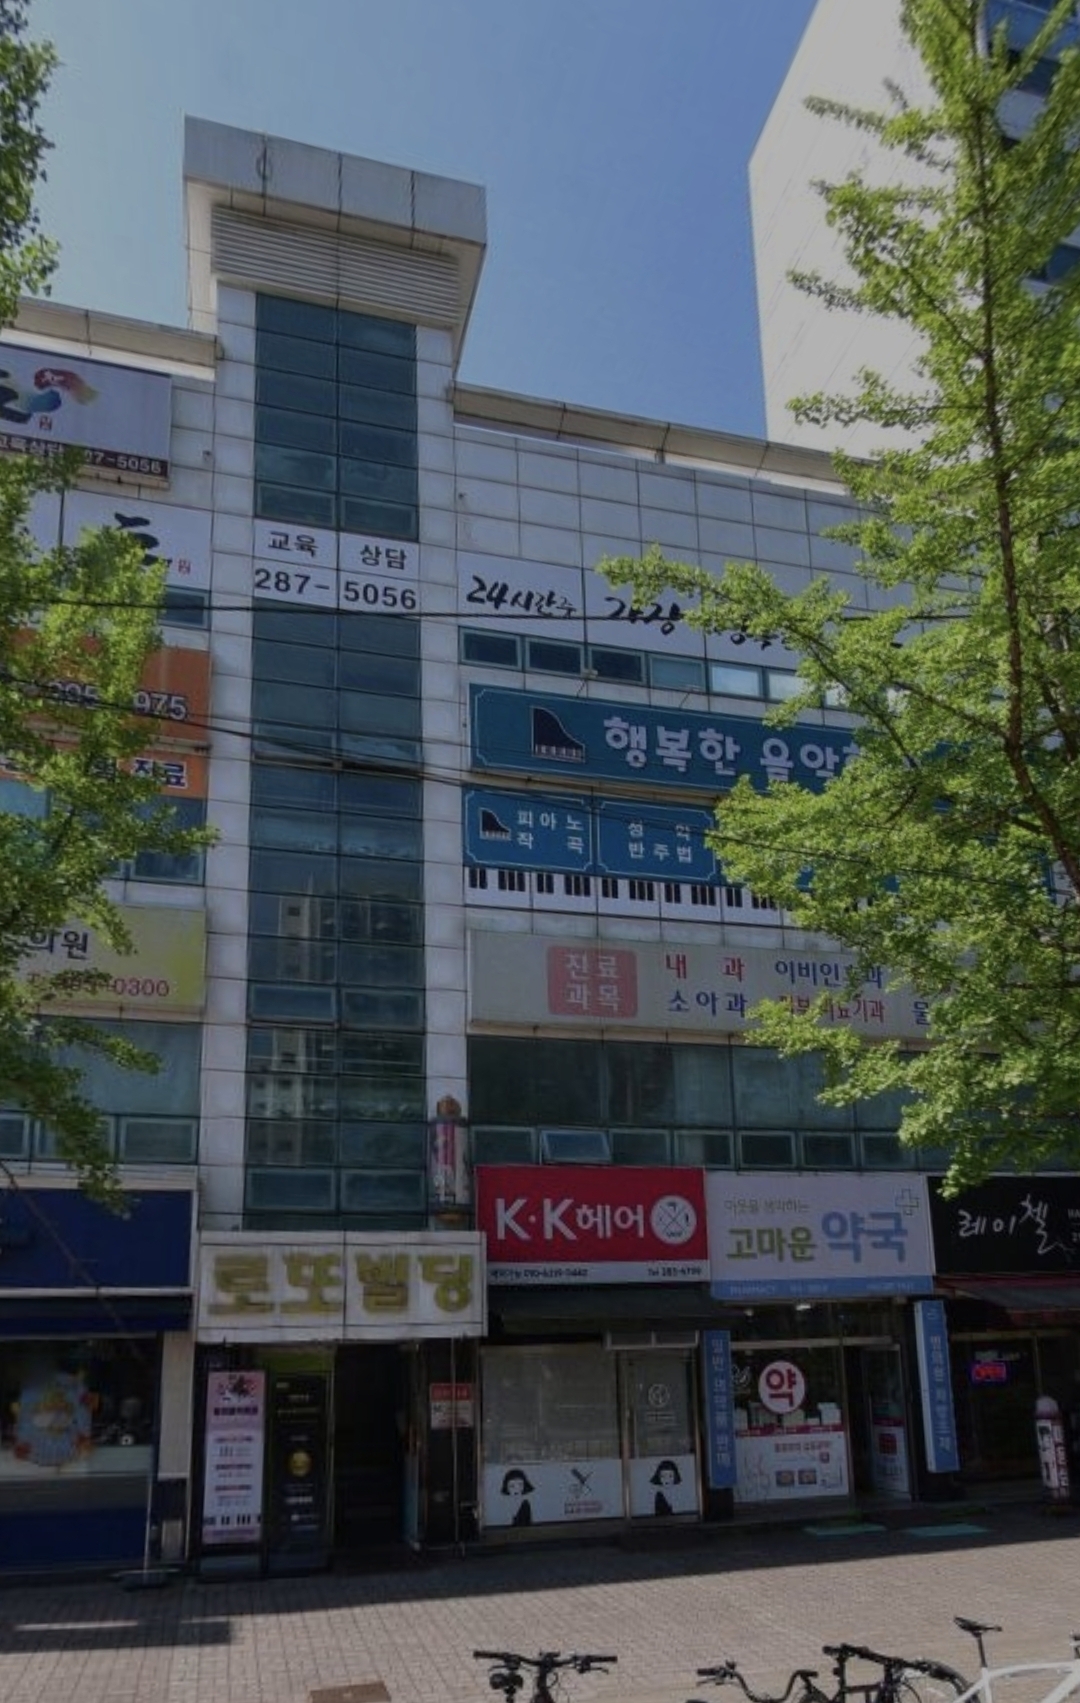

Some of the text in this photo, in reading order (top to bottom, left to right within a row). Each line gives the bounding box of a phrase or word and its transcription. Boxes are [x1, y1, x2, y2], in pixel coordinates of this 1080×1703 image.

[268, 531, 407, 570] 교육 상담
[603, 716, 741, 776] 행복한
[566, 950, 619, 980] 진료
[566, 982, 619, 1012] 과목
[668, 989, 748, 1019] 소아과
[727, 1211, 908, 1264] 고마운 약국
[957, 1192, 1062, 1255] 레이첼
[765, 1368, 797, 1408] 약
